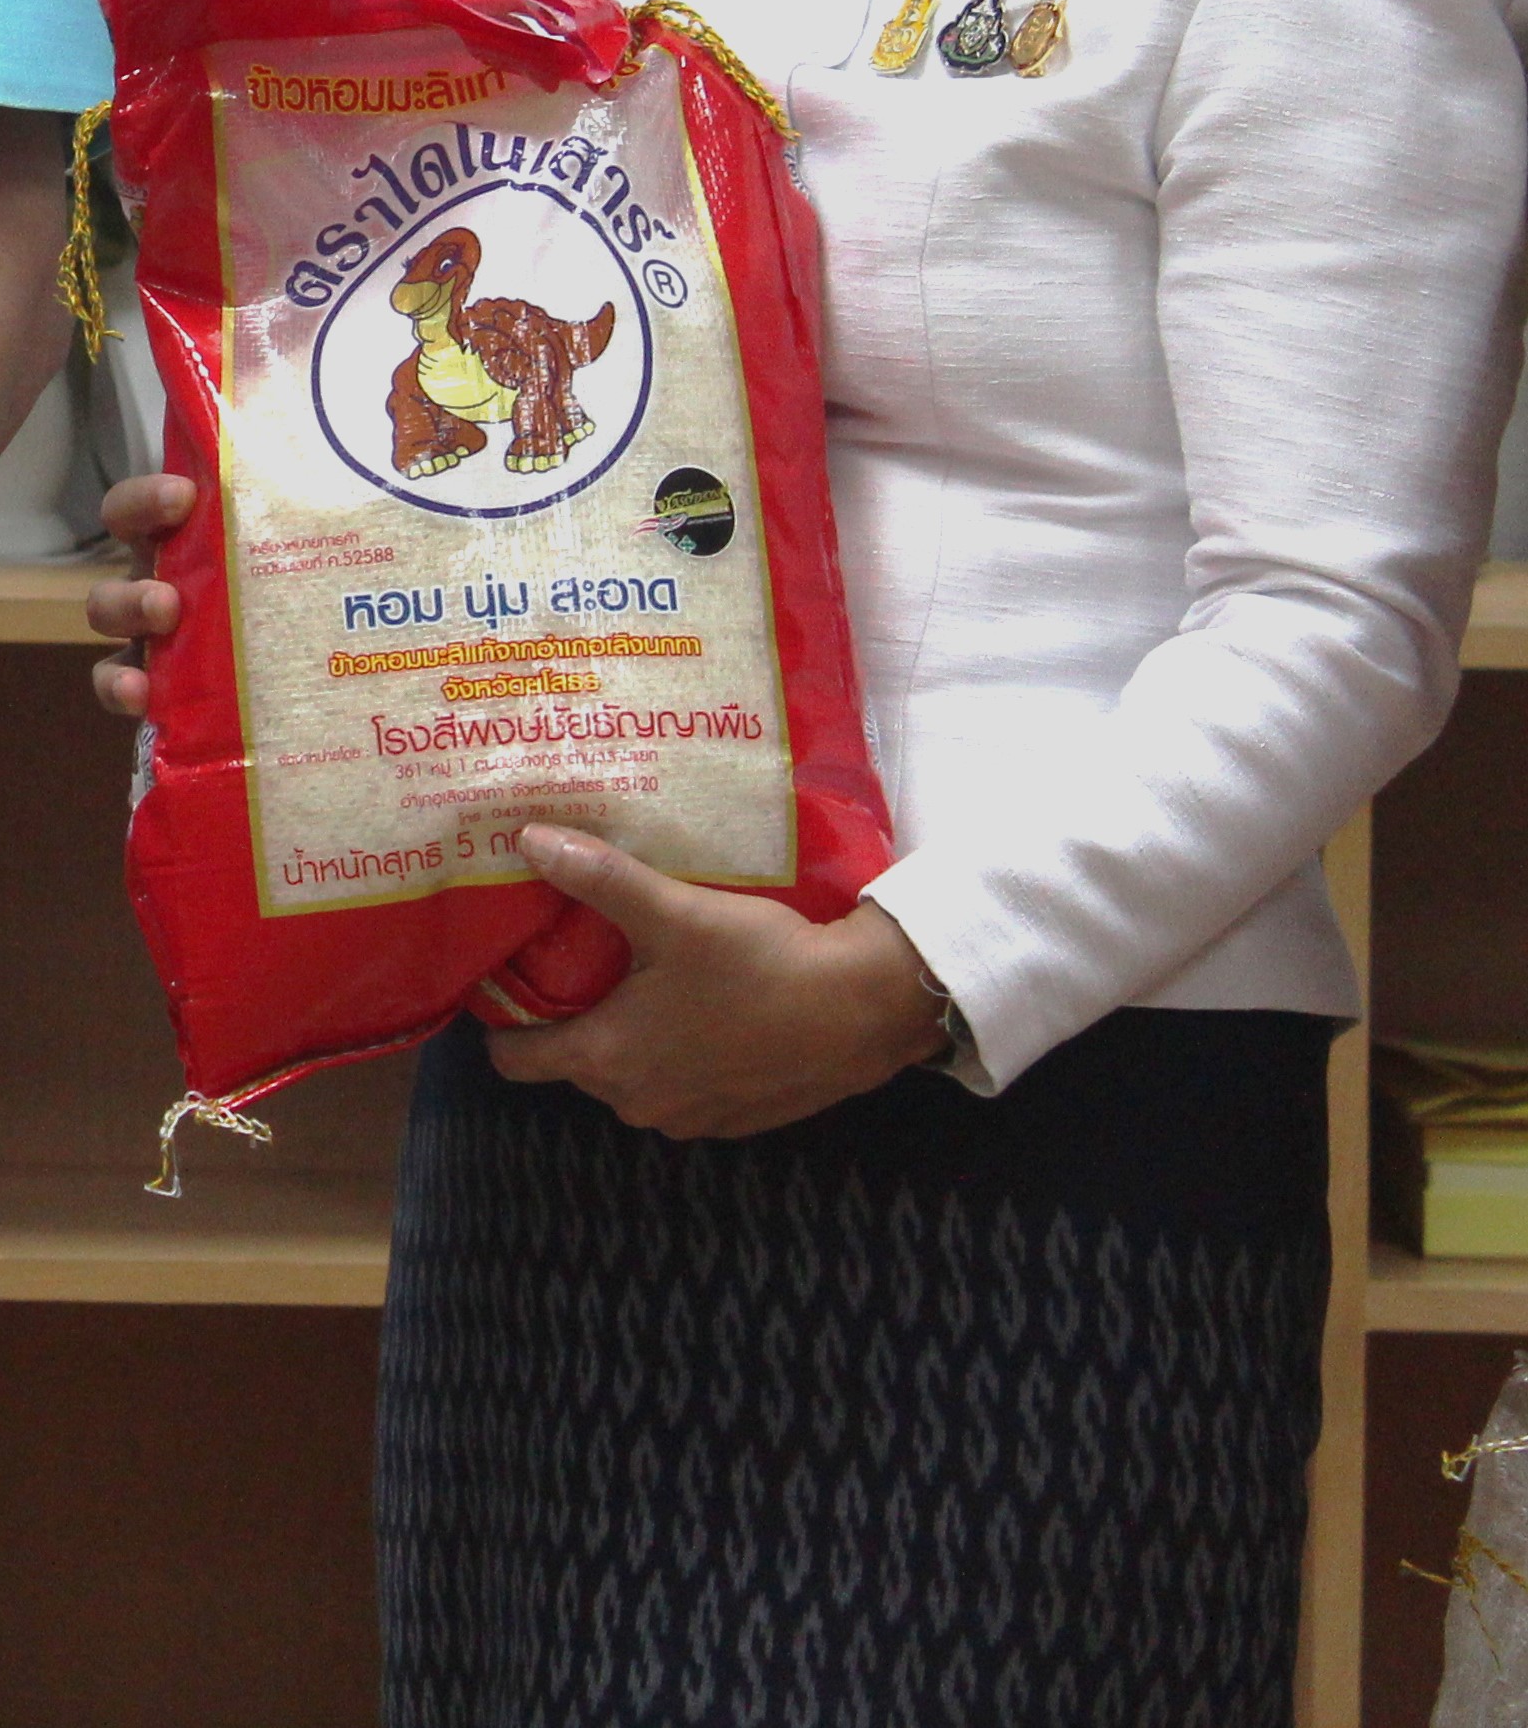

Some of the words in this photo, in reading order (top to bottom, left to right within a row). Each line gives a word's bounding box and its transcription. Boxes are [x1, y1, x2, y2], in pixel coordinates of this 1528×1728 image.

[344, 587, 443, 631] หอม
[464, 575, 530, 630] นุ่ม
[550, 576, 678, 614] สะอาด
[329, 633, 703, 677] ข้าวหอมมะลิแท้จากอำเภอเลิงนกทา
[442, 669, 601, 702] จังหวัดยโสธร
[395, 762, 421, 779] 361
[611, 777, 659, 792] 35120
[282, 841, 443, 886] น้ำหนักสุทธิ
[456, 831, 475, 859] 5
